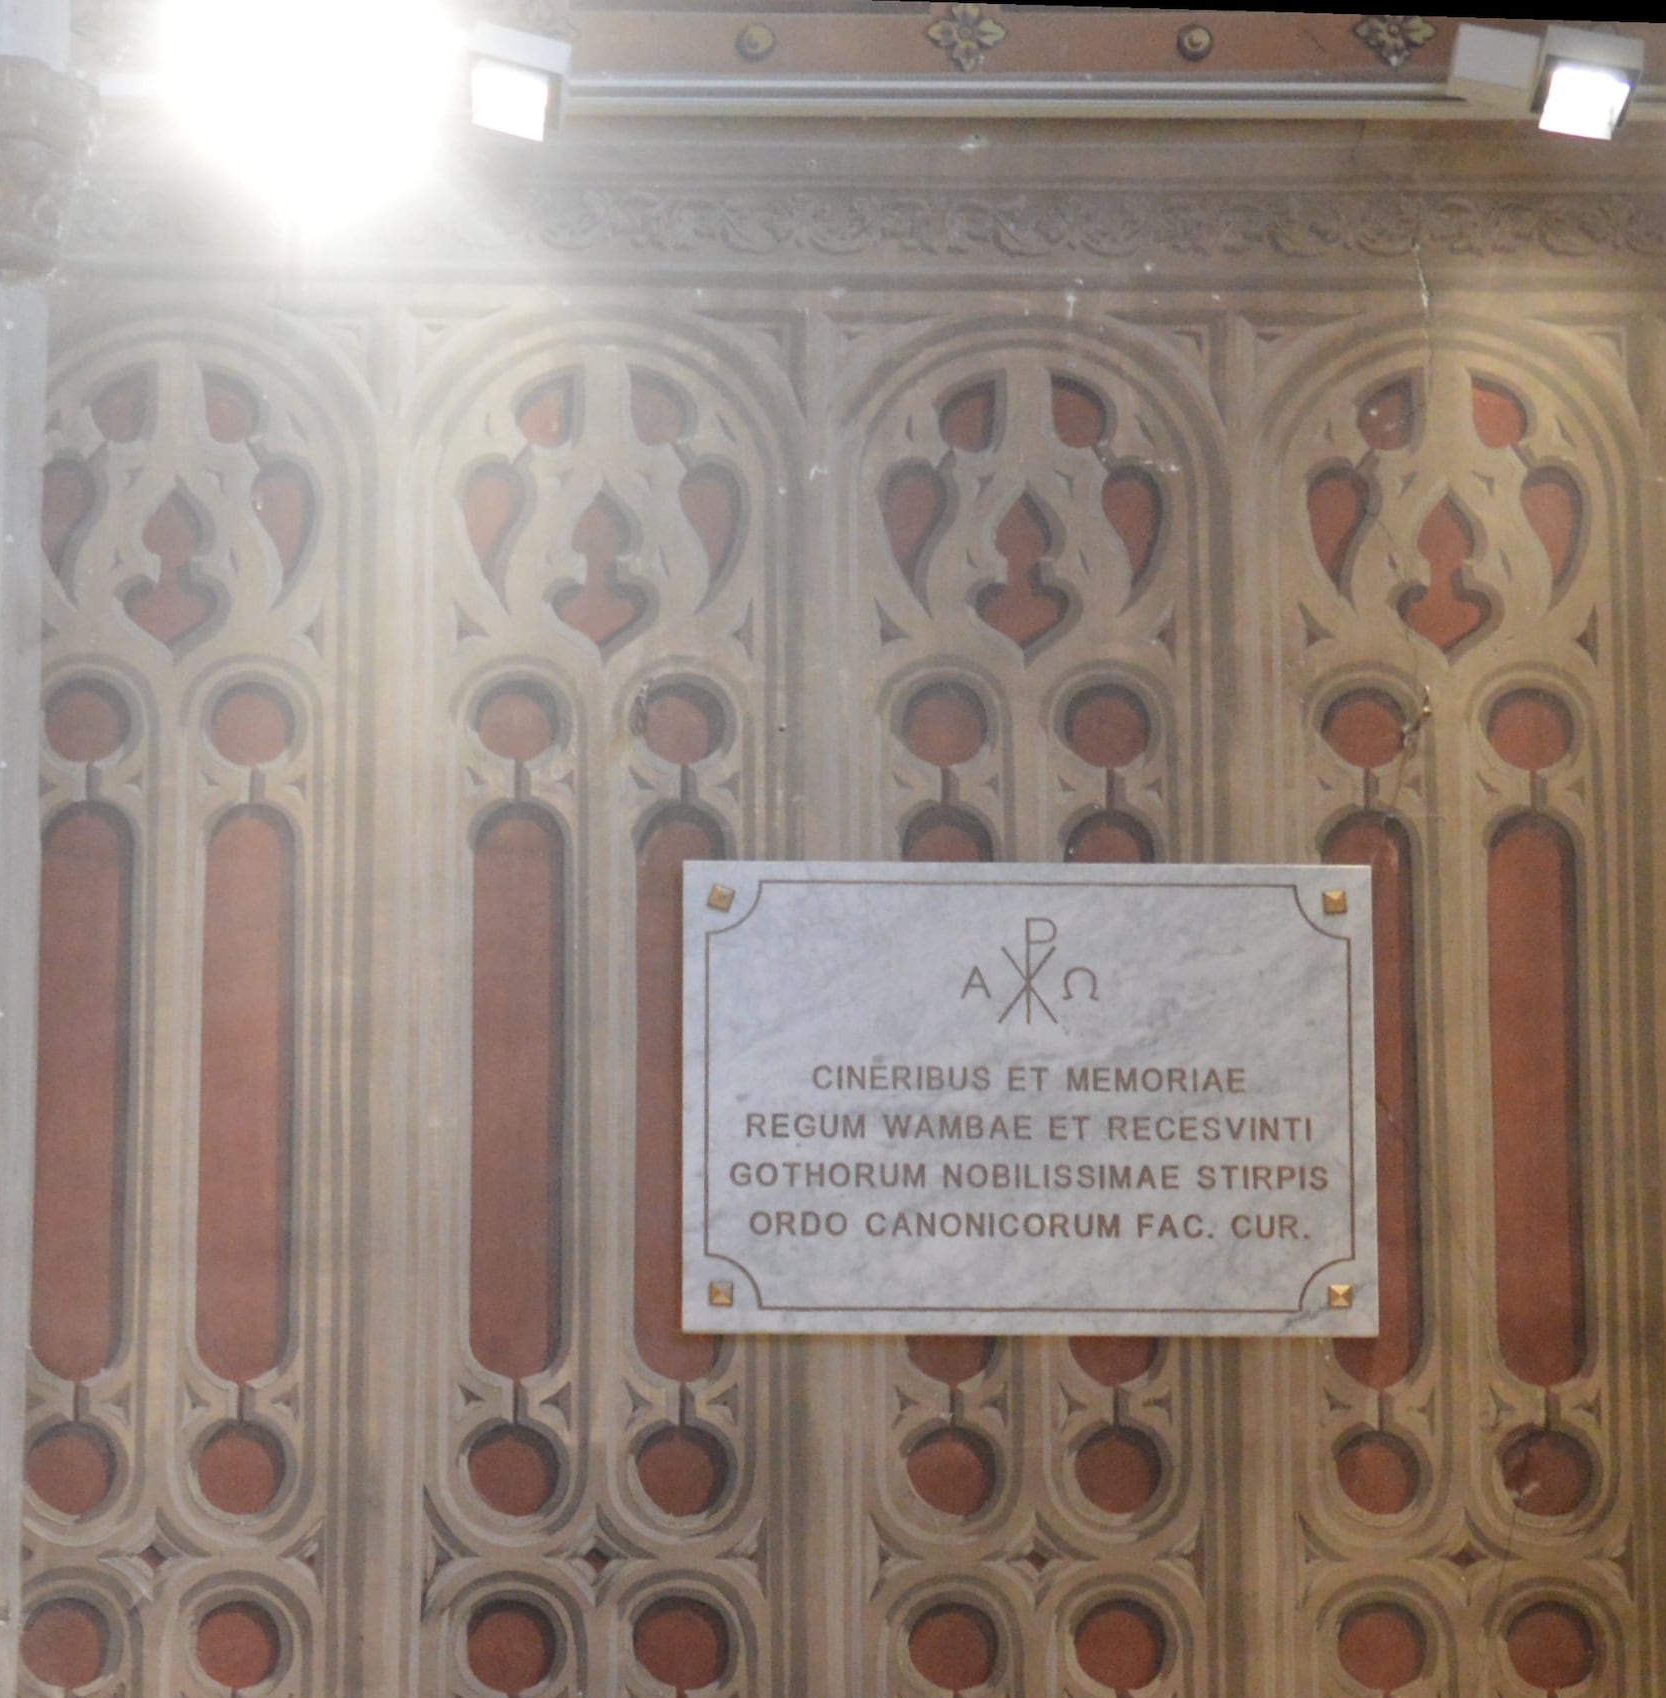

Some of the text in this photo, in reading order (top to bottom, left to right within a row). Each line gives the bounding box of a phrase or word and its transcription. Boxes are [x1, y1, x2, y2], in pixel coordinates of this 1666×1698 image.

[811, 1064, 1247, 1095] CINERIBUS ET MEMORIAE
[745, 1112, 1313, 1143] REGUM WAMBAE ET RECESVINTI
[729, 1161, 1329, 1192] GOTHORUM NOBILISSIMAE STIRPIS
[748, 1210, 1311, 1241] ORDO CANONICORUM FAC. CUR.
